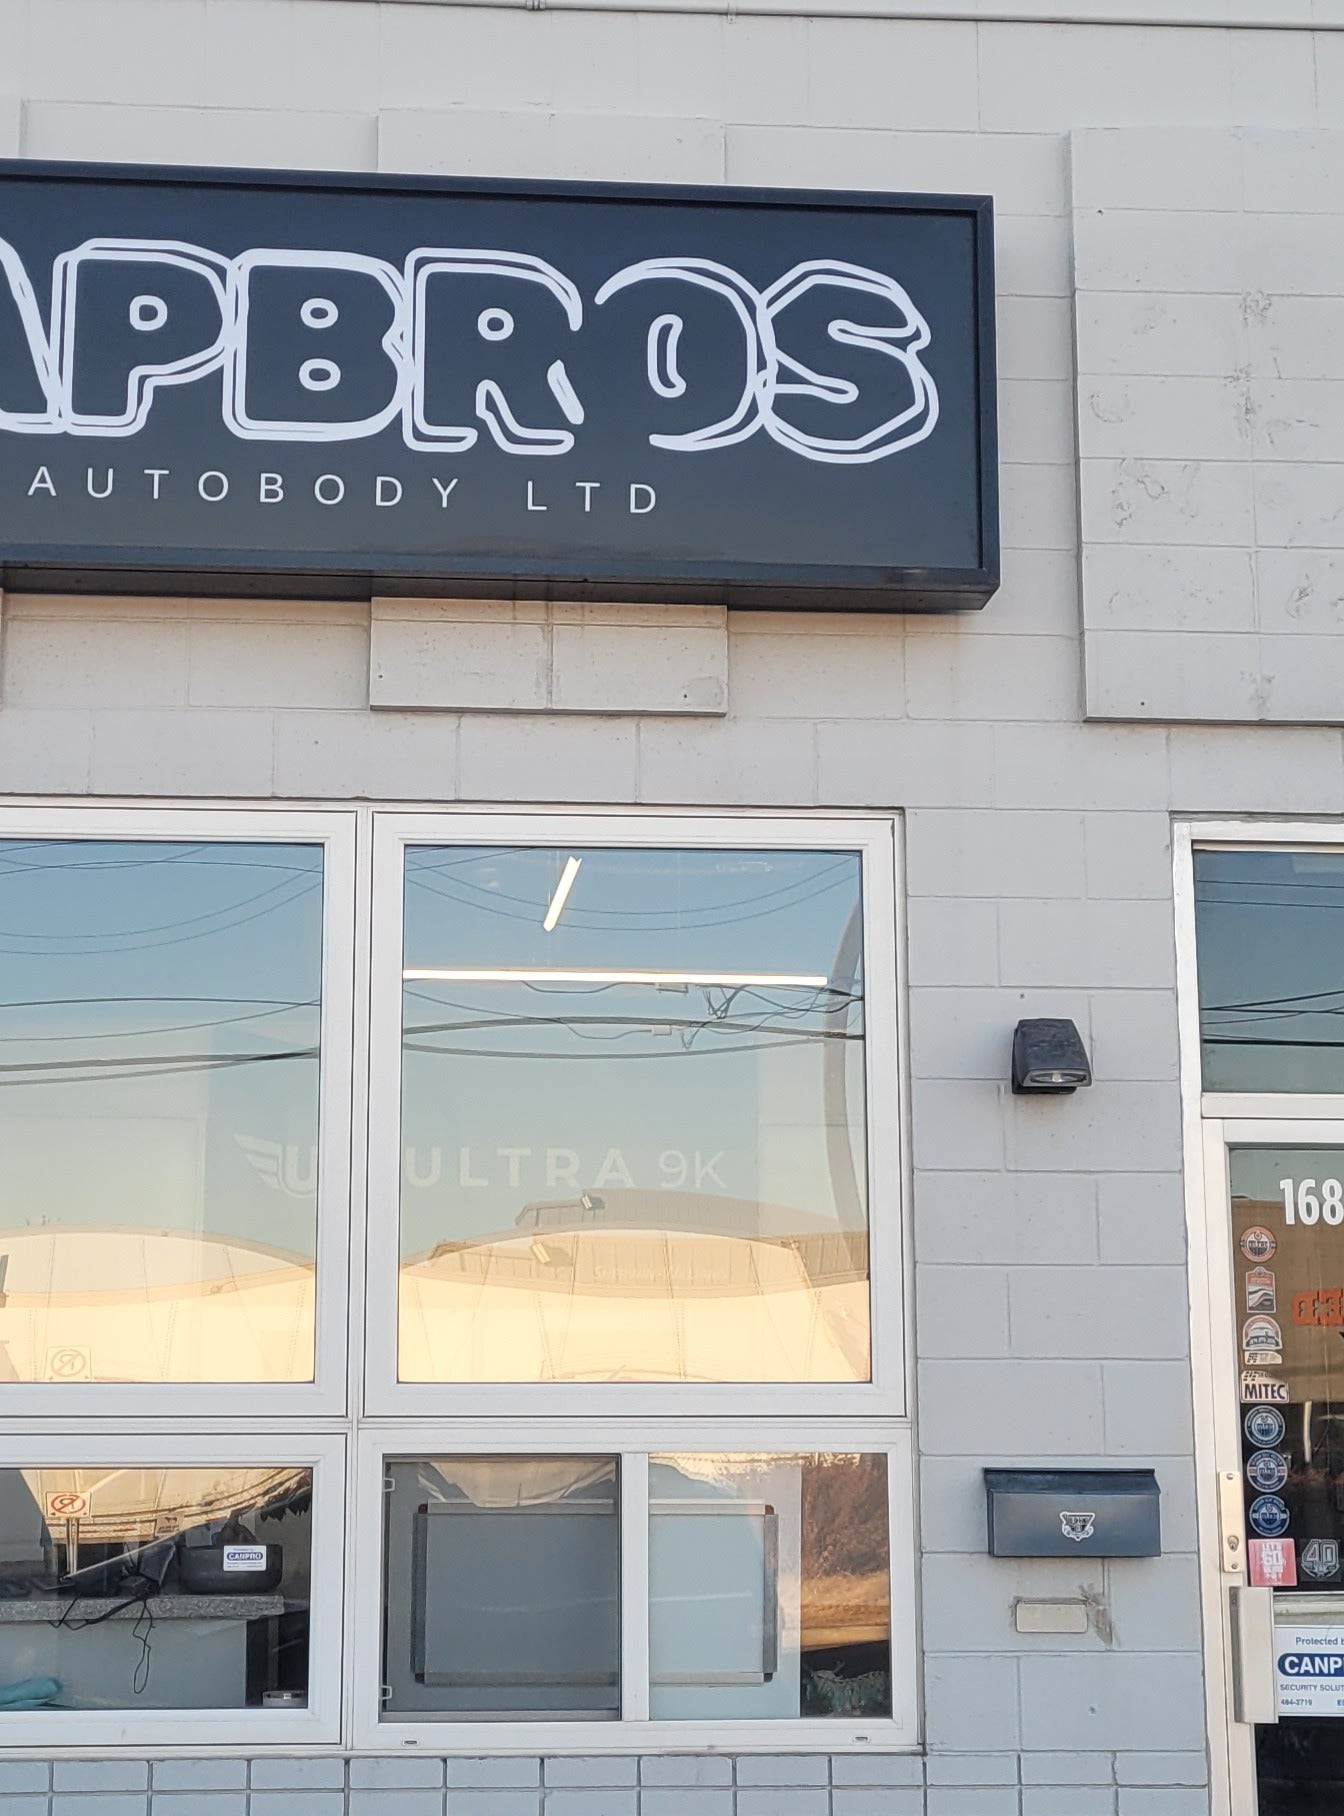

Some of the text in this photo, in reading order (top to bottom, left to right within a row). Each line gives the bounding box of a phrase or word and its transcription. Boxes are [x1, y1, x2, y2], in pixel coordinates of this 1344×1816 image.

[27, 465, 657, 513] AUTOBODY LTD
[405, 1146, 636, 1189] ULTRA
[657, 1148, 727, 1189] 9K
[1244, 1383, 1286, 1400] MITEC
[1295, 1636, 1338, 1646] Protected
[1280, 1684, 1317, 1692] SECURITY
